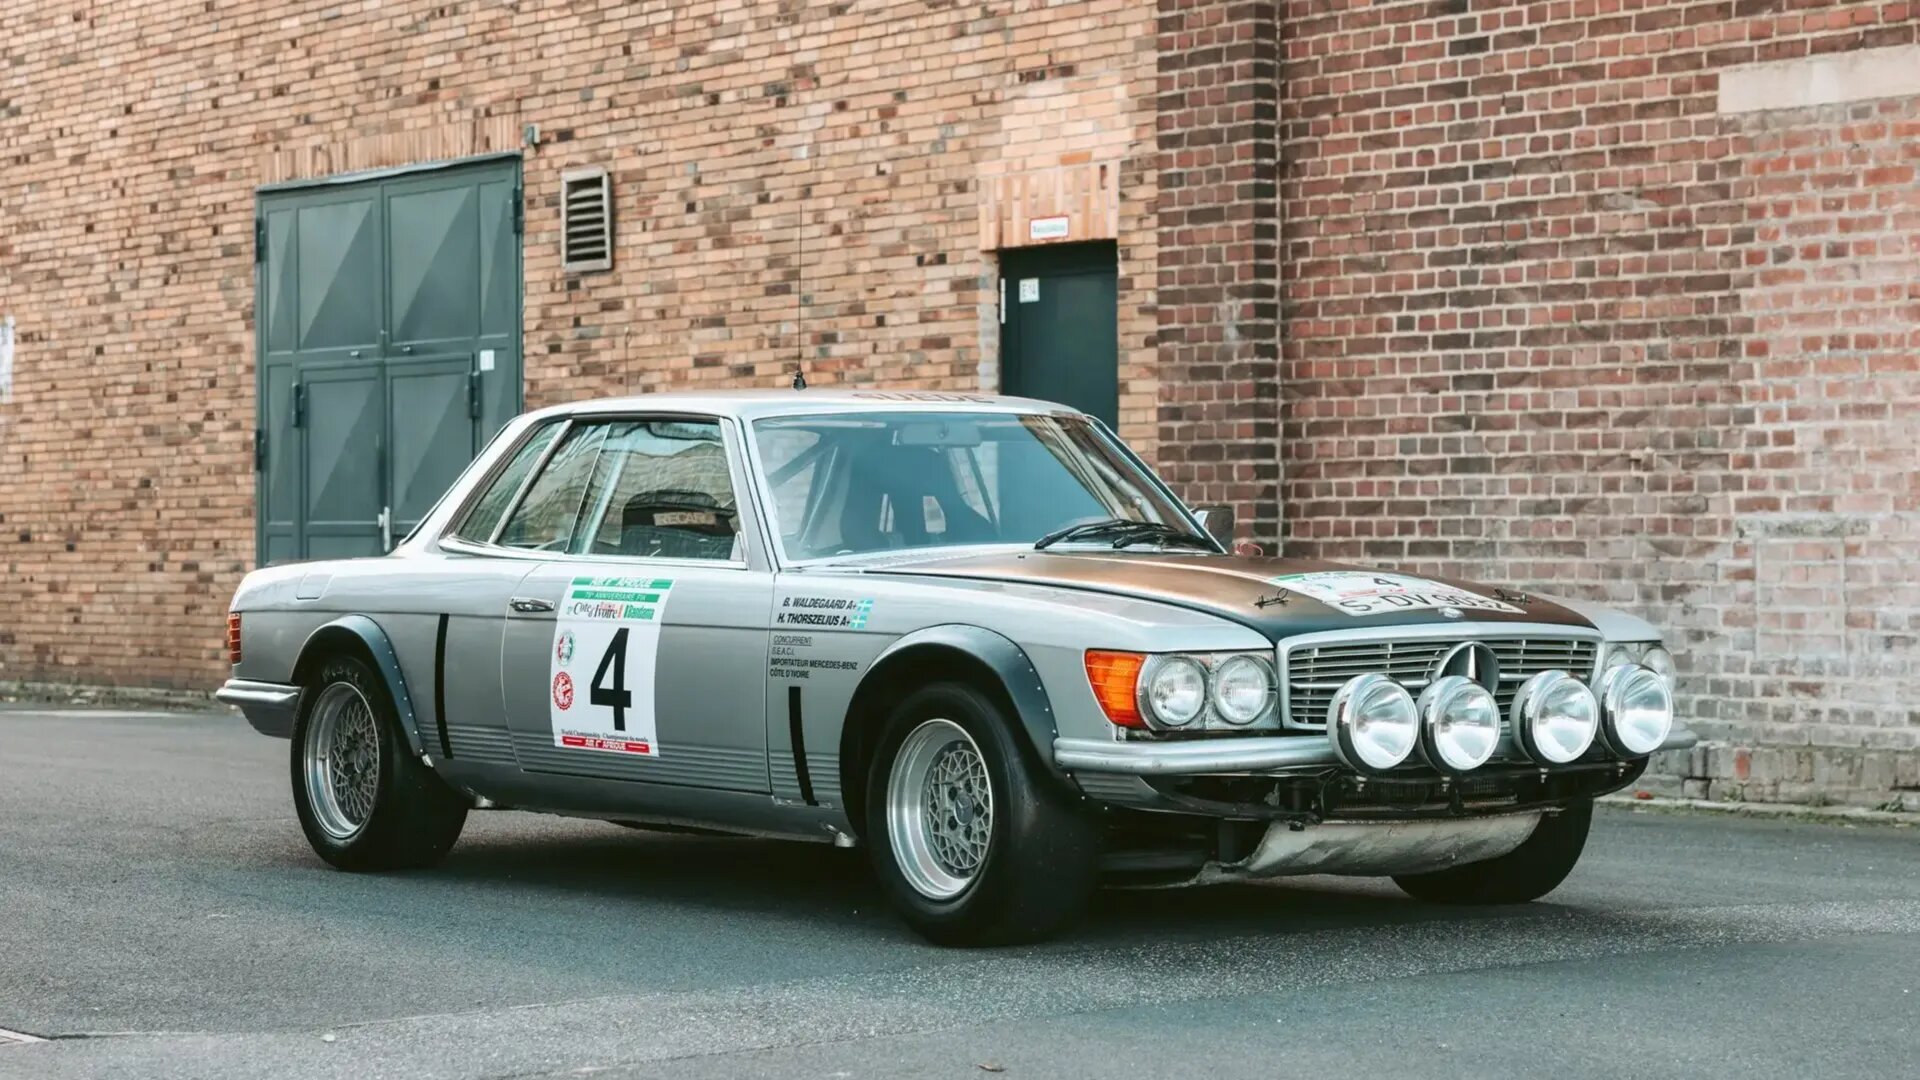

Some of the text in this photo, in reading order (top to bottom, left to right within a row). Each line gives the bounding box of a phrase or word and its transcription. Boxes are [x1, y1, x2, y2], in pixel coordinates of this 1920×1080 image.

[782, 597, 790, 607] B.
[792, 598, 847, 609] WALDEGAARD
[777, 613, 785, 623] H.
[787, 613, 840, 626] THORSZELIUS
[770, 658, 858, 670] IMPORTATEUR MERCEDES-BENZ
[590, 627, 632, 731] 4
